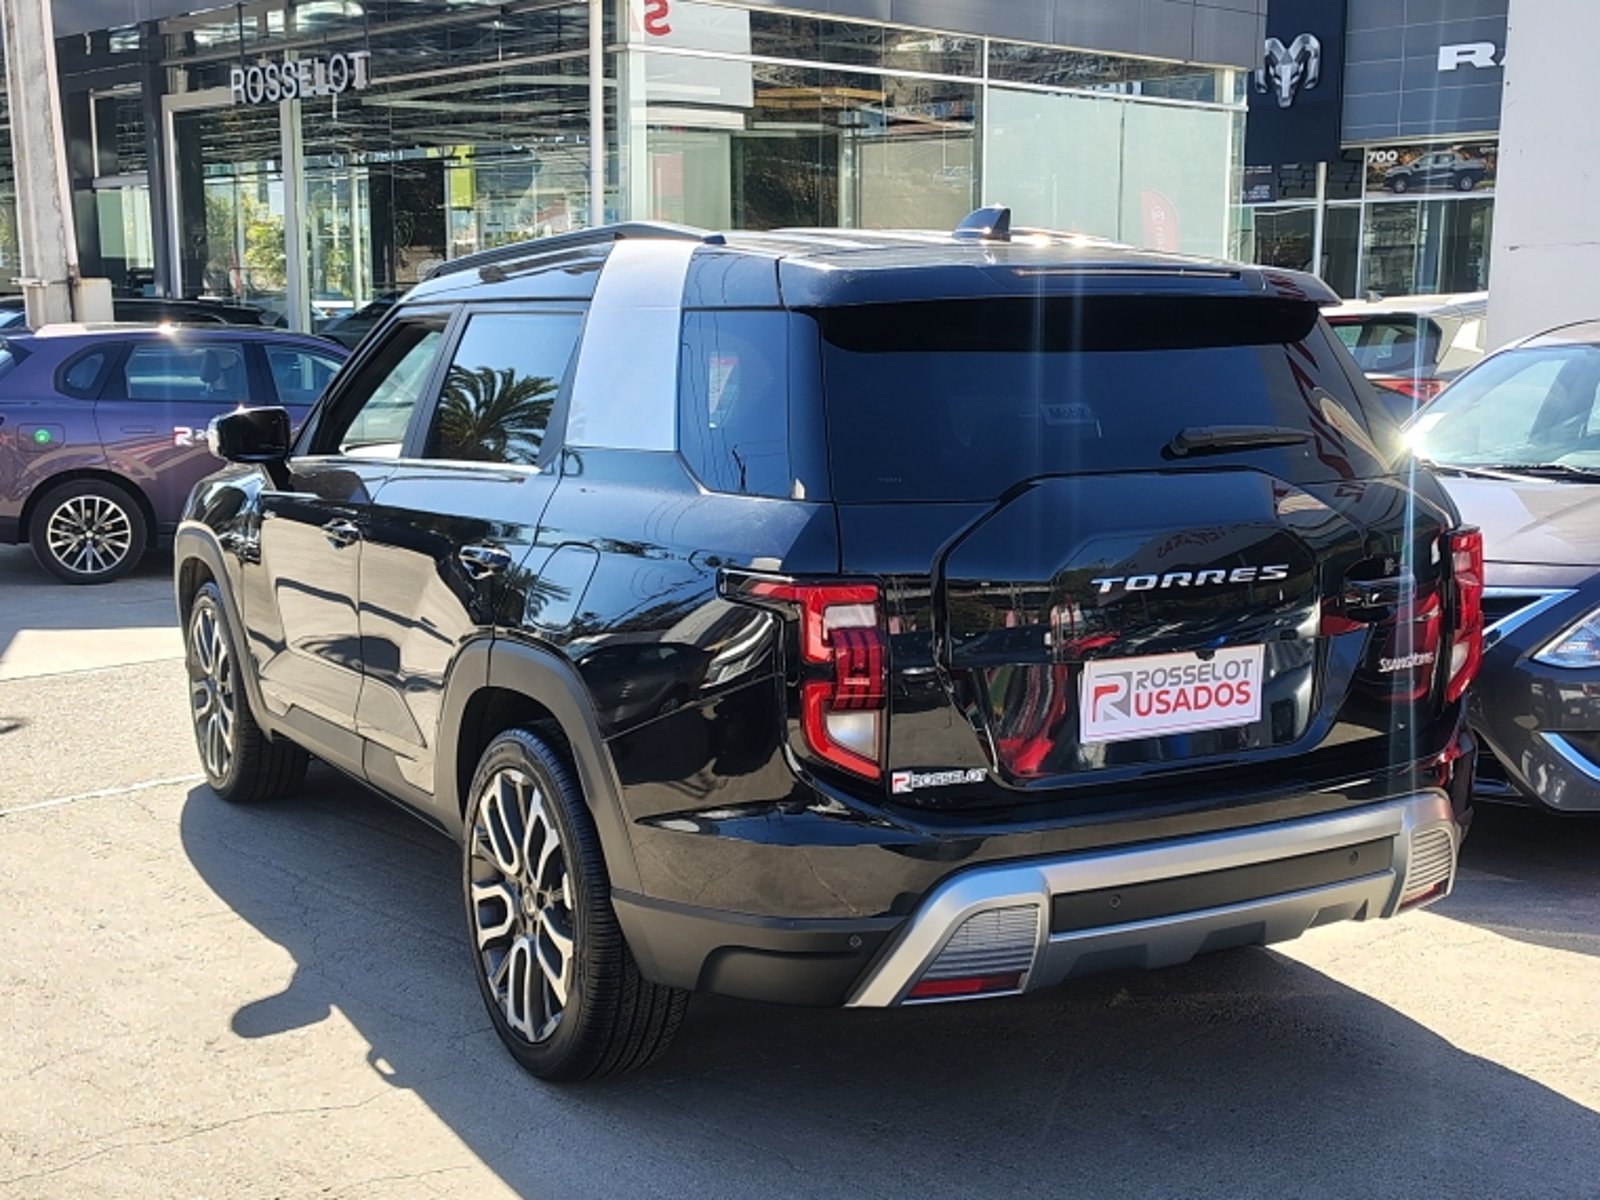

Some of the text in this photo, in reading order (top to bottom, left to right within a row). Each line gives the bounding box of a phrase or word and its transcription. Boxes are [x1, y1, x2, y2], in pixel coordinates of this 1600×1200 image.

[1437, 42, 1506, 72] R
[230, 51, 371, 104] ROSSELOT
[1368, 150, 1398, 163] 700
[1090, 564, 1289, 593] TORRES
[1136, 659, 1253, 690] ROSSELOT
[1135, 681, 1251, 716] USADOS
